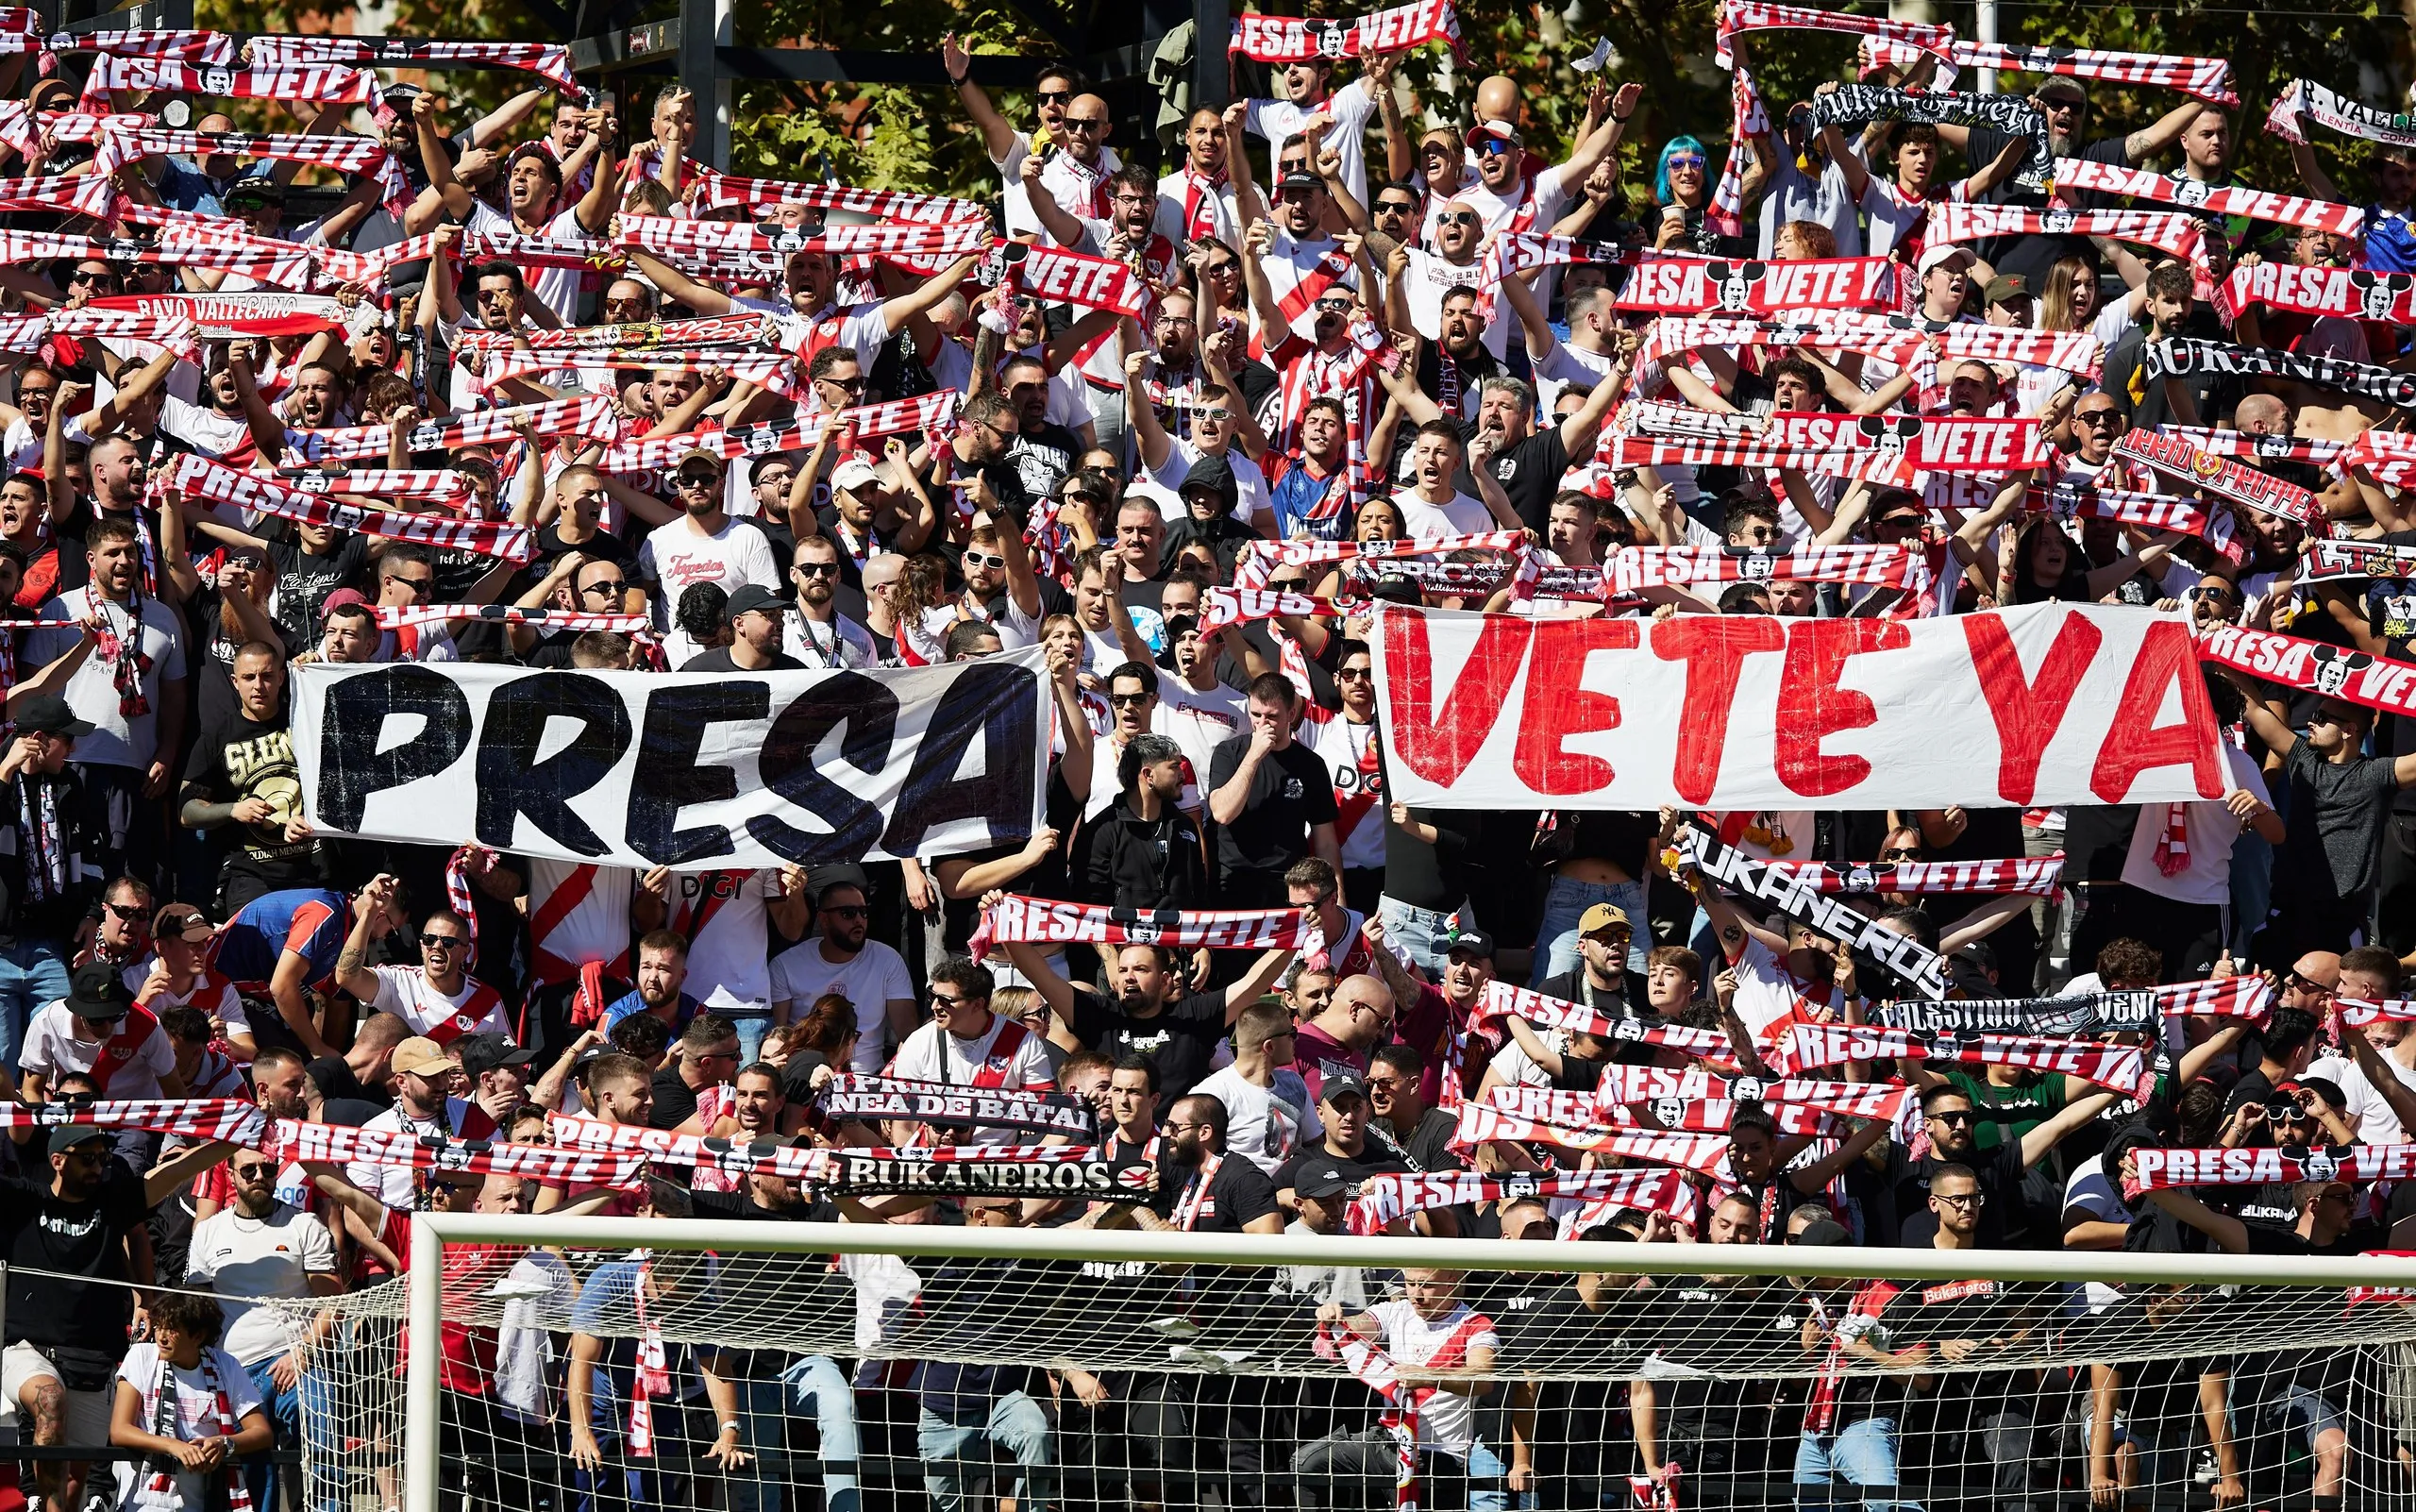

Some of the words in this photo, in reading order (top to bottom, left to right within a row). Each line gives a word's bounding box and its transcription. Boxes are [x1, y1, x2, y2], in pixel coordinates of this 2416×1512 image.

[1359, 3, 1434, 51] VETE
[249, 63, 352, 101] VETE
[2077, 51, 2182, 82] VETE
[2225, 188, 2335, 227] VETE
[621, 213, 755, 250] PRESA
[824, 225, 930, 253] VETE
[2089, 210, 2190, 250] VETE
[159, 241, 264, 276] VETE
[1025, 250, 1122, 303] VETE
[1763, 260, 1859, 306] VETE
[2235, 262, 2347, 311] PRESA
[194, 296, 298, 321] VALLECANO
[1949, 323, 2043, 364] VETE
[1920, 421, 2010, 464] VETE
[176, 454, 310, 521] PRESA
[379, 514, 481, 550] VETE
[1925, 471, 2006, 510] RES
[1793, 545, 1895, 584] VETE
[1384, 606, 1912, 806] VETE
[1962, 610, 2225, 806] YA
[315, 663, 1040, 868] PRESA
[680, 873, 745, 900] DIGI
[1895, 861, 2002, 892] VETE
[998, 899, 1108, 943] RESA
[1179, 909, 1287, 949] VETE
[1882, 999, 2025, 1033] PALESTINA
[1980, 1035, 2083, 1075] VETE
[2089, 1044, 2143, 1092] YA
[95, 1100, 215, 1135] VETE
[916, 1094, 974, 1117] DE
[1783, 1080, 1888, 1115] VETE
[277, 1119, 417, 1166] PRESA
[492, 1144, 605, 1184] VETE
[2138, 1149, 2285, 1190] PRESA
[848, 1157, 1113, 1192] BUKANEROS
[1556, 1168, 1663, 1211] VETE
[1924, 1282, 1995, 1303] Bukaneros
